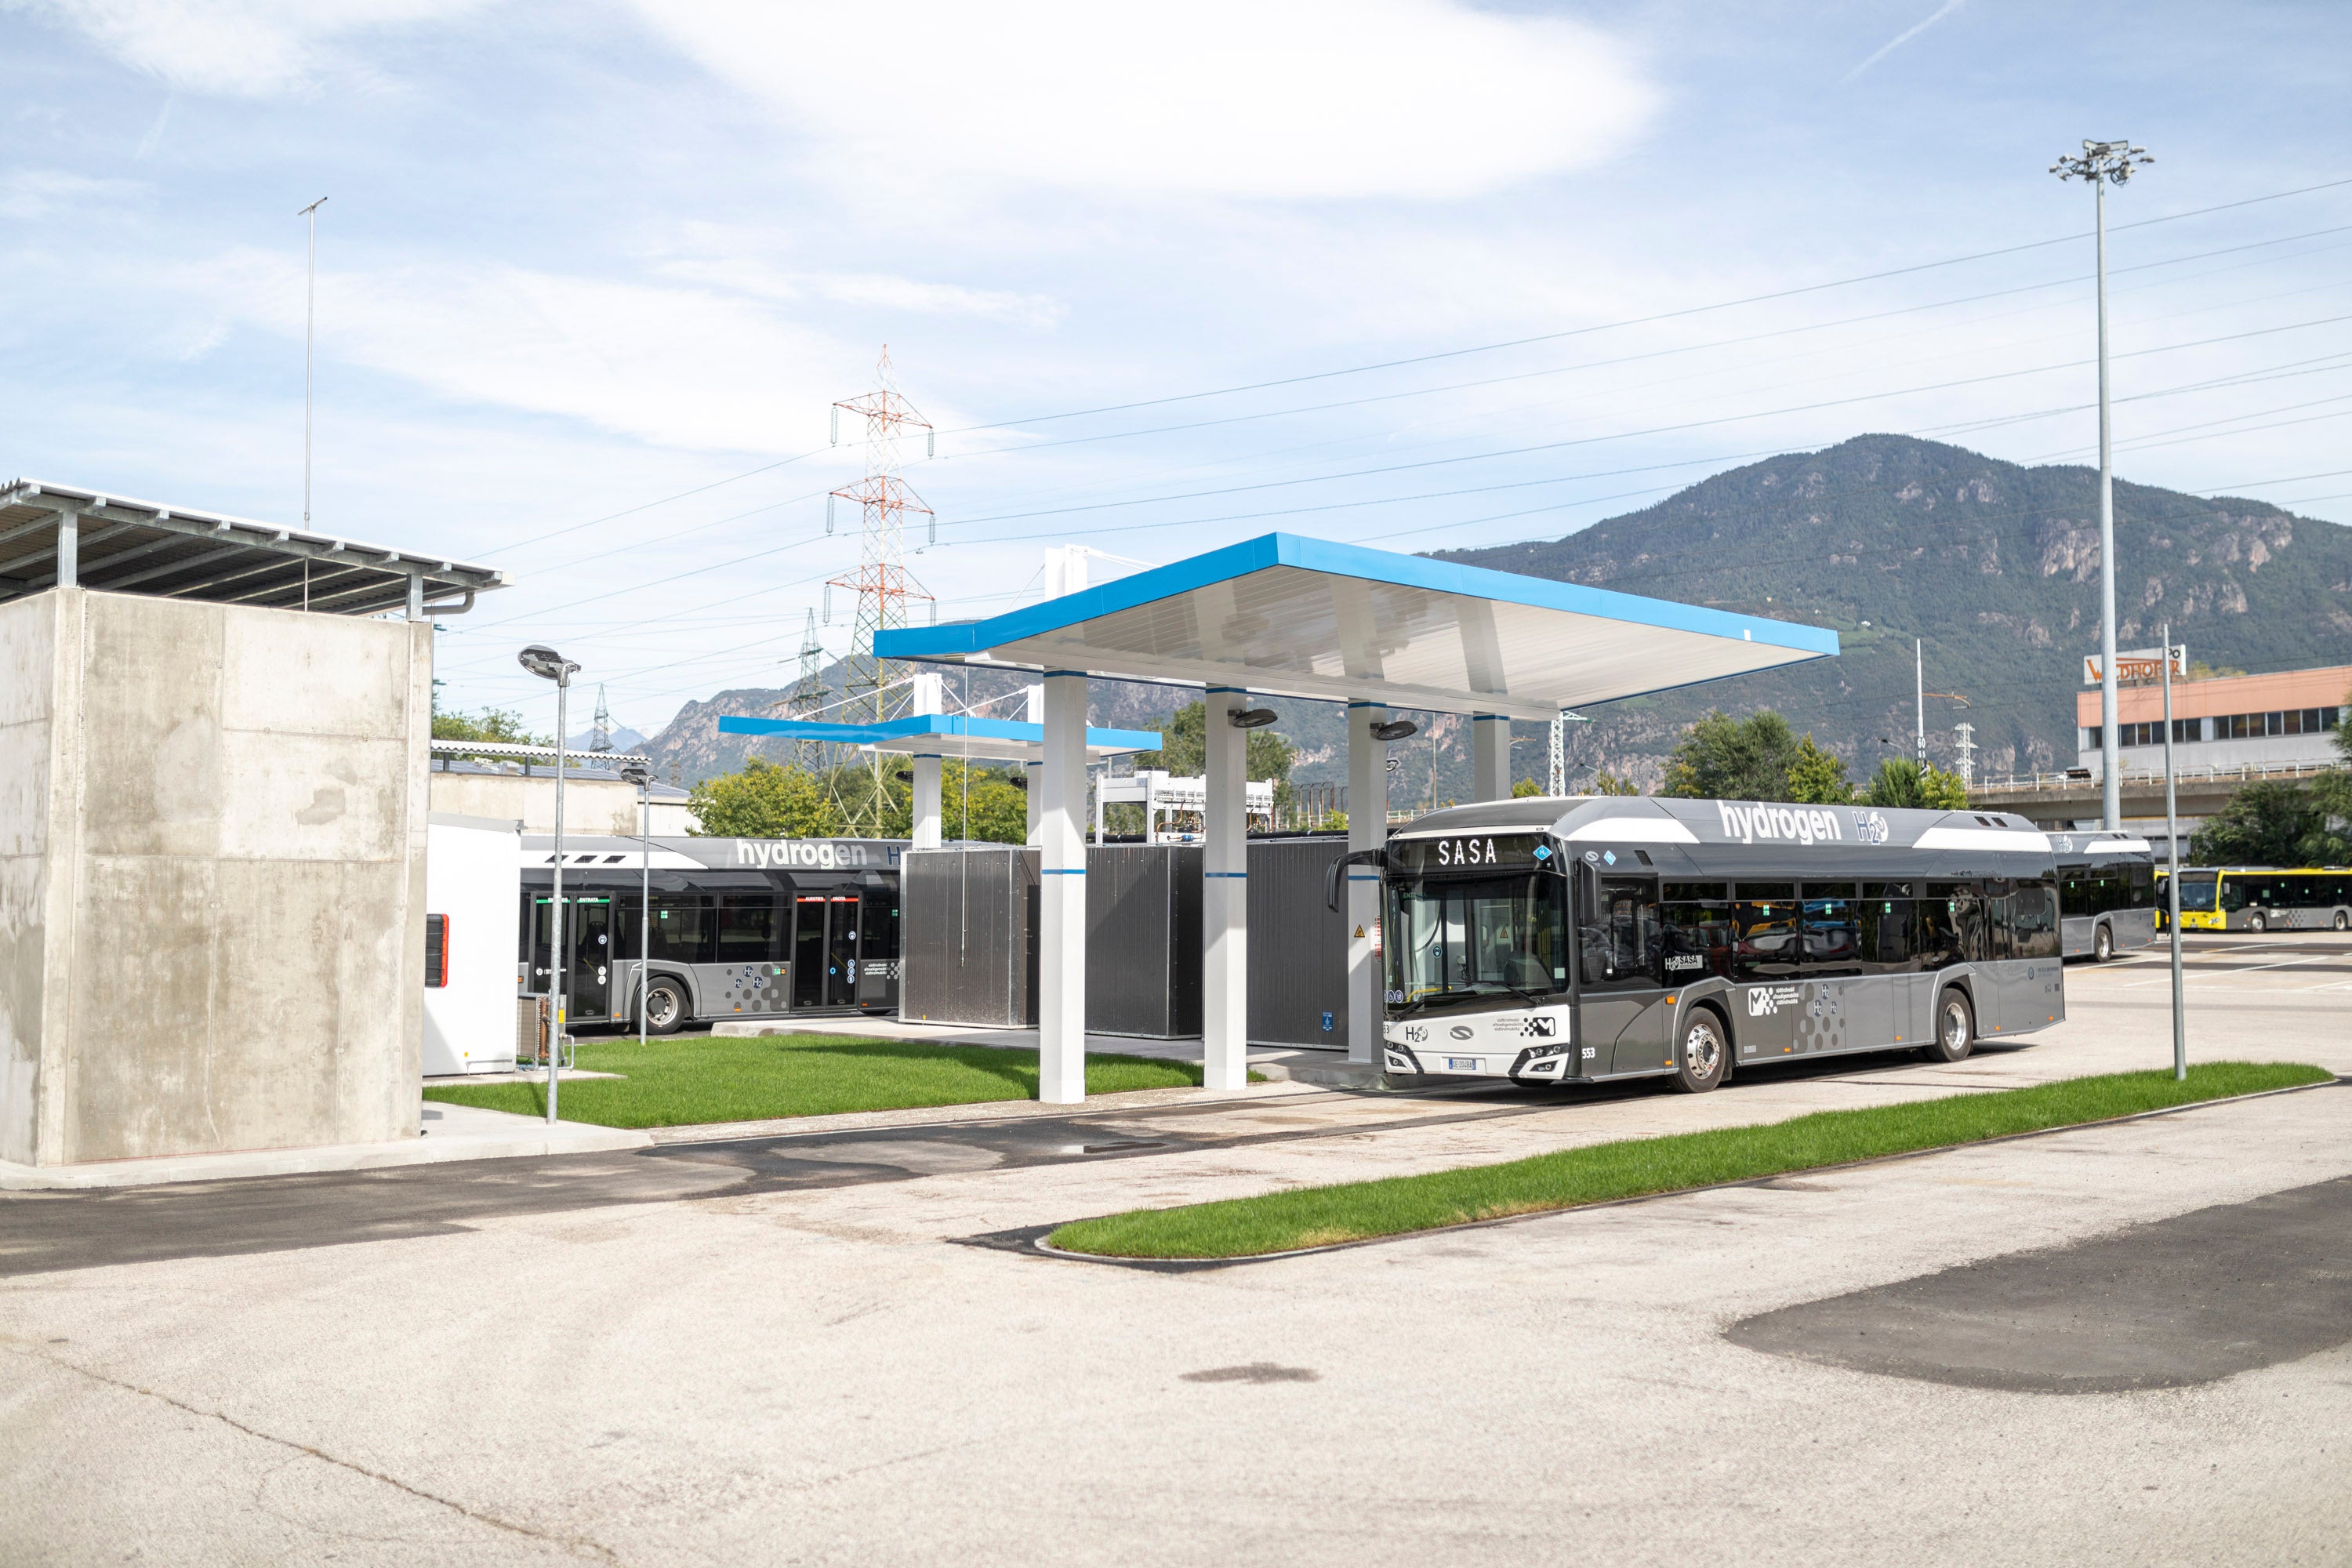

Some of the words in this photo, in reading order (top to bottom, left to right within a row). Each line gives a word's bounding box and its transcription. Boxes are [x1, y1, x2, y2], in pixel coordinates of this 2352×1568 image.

[1918, 737, 1926, 749] 60
[1716, 800, 1842, 845] hydrogen
[736, 839, 867, 869] hydrogen
[1439, 838, 1497, 866] SASA
[1679, 956, 1697, 964] SASA
[744, 967, 753, 976] H2
[753, 978, 763, 986] H2
[1821, 985, 1829, 998] H2
[1813, 1000, 1822, 1014] H2
[1582, 1047, 1595, 1059] 553
